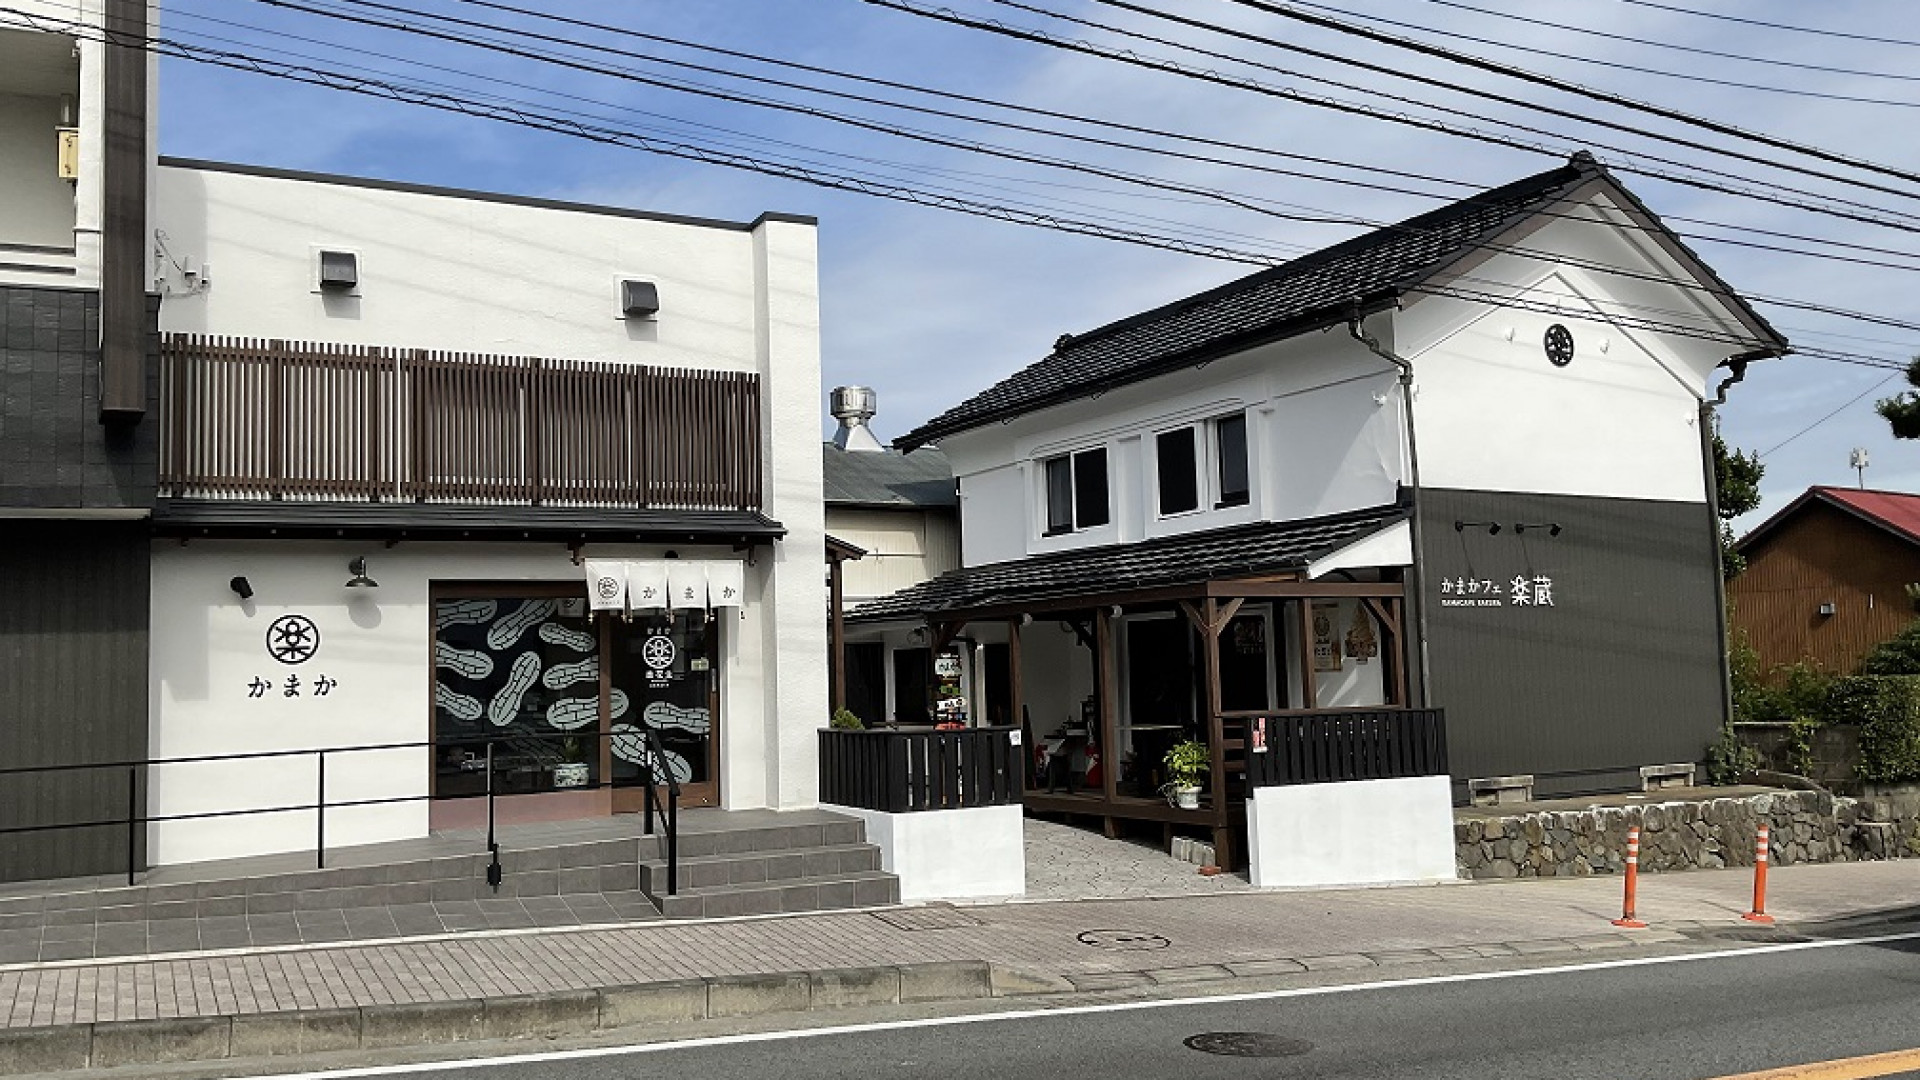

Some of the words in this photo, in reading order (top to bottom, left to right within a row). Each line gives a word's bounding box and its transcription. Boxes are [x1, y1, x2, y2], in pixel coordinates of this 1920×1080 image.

[1441, 576, 1502, 595] かまかフェ
[1509, 575, 1555, 607] 楽蔵
[247, 673, 338, 698] かまか
